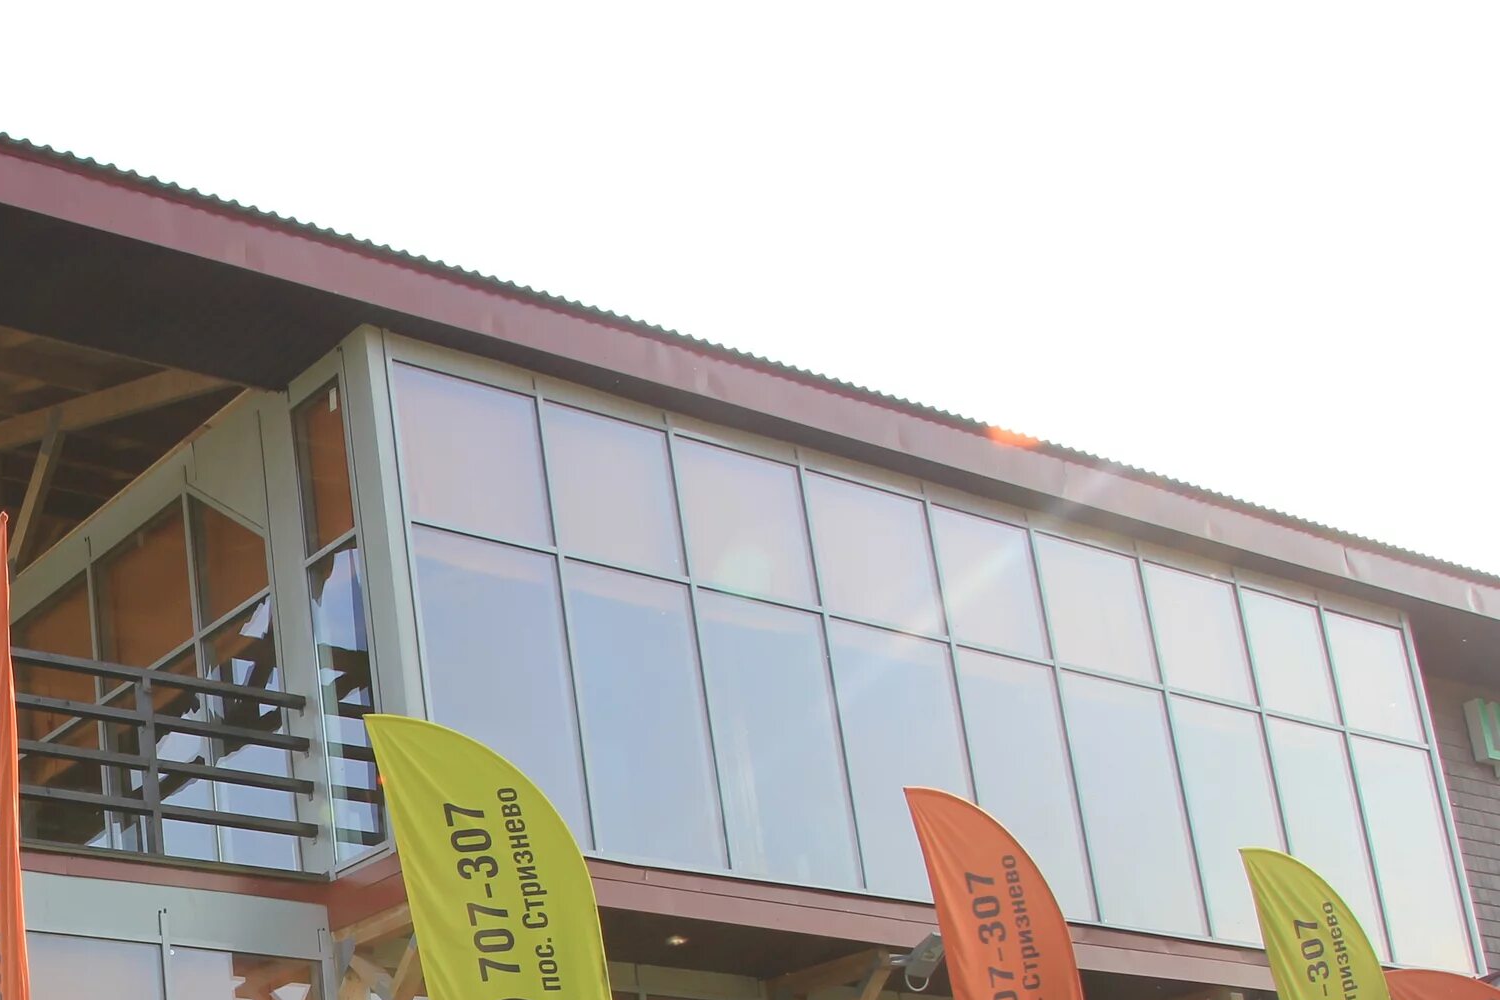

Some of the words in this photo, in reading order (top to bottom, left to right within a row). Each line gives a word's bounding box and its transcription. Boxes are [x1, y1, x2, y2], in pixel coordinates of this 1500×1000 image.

[443, 802, 521, 982] 707-307
[496, 787, 549, 929] Стризнево
[1001, 854, 1041, 990] Стризнево
[535, 937, 562, 991] пос.
